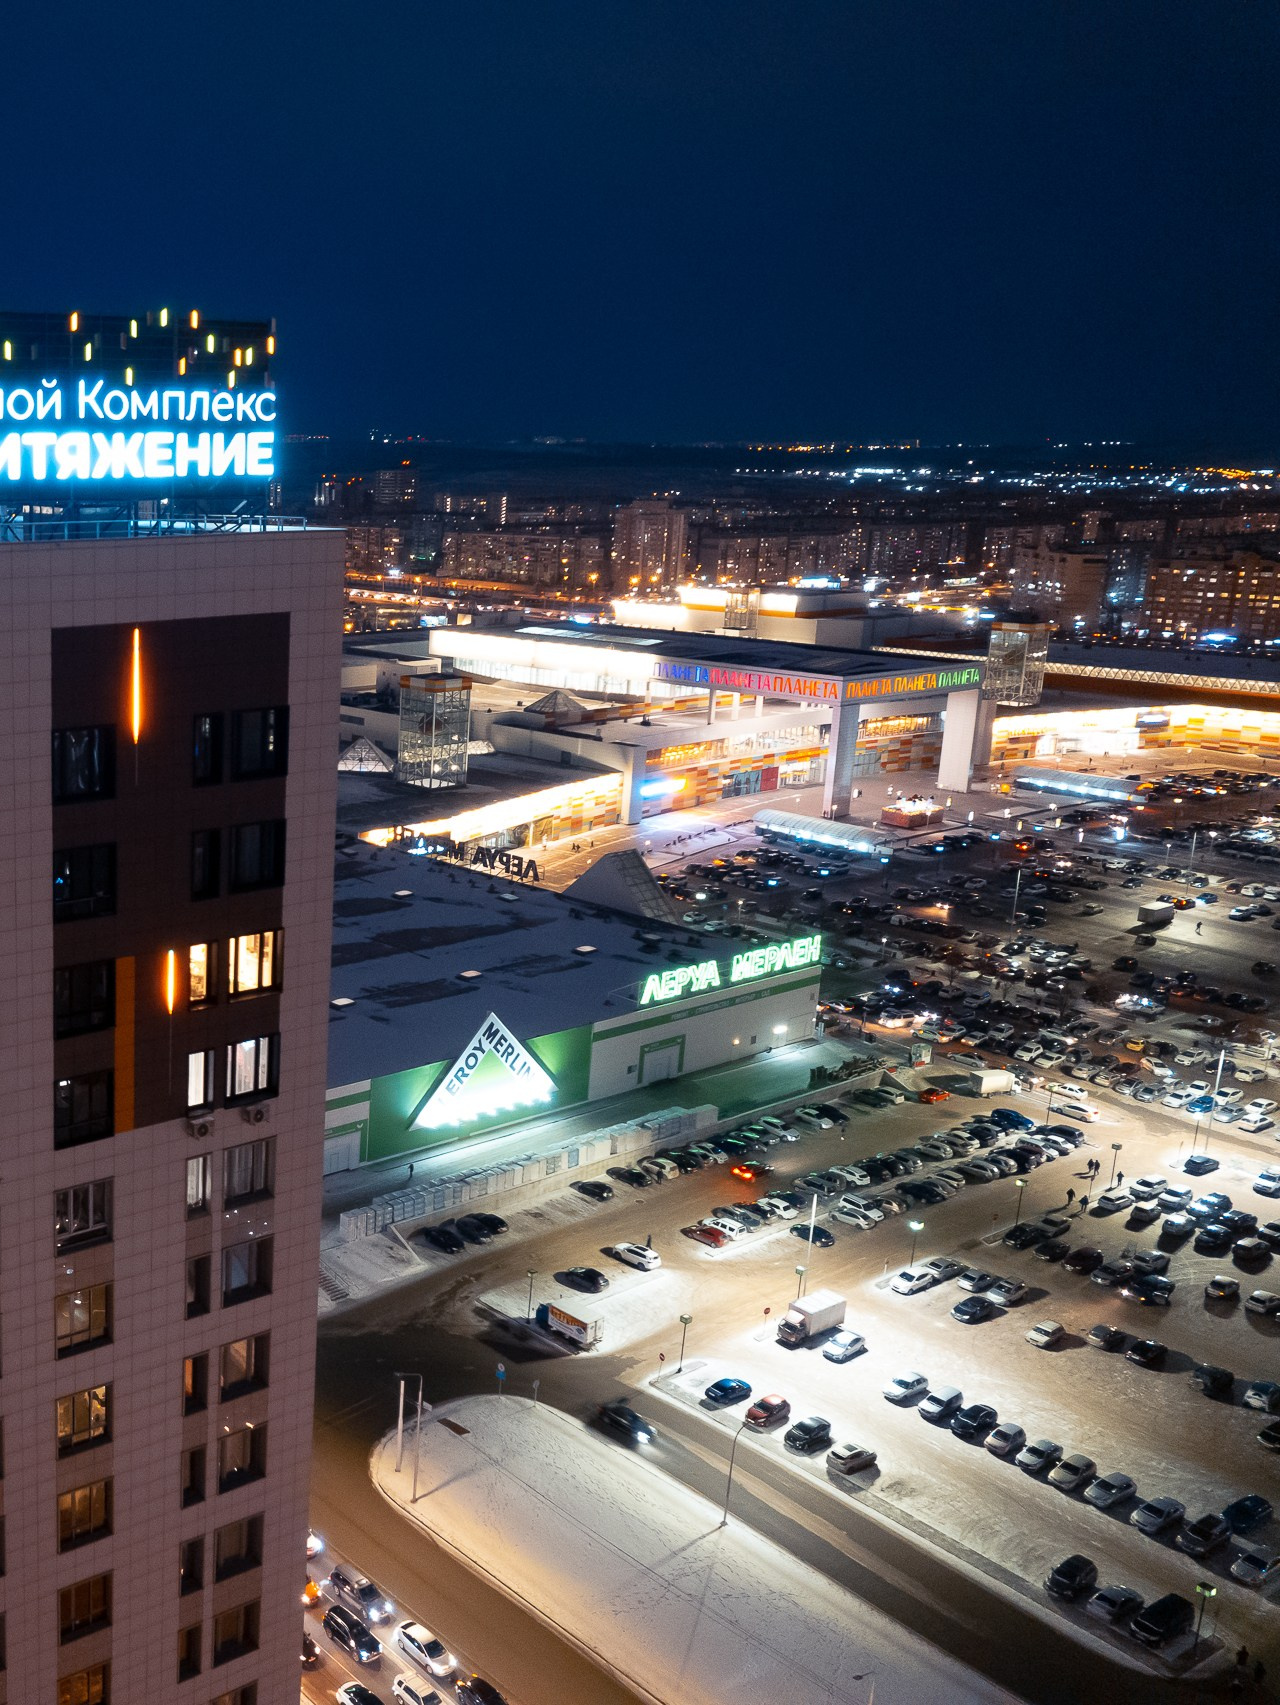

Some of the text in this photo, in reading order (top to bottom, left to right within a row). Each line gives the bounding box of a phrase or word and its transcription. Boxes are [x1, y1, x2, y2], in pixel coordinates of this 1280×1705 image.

[78, 379, 277, 422] Комплекс
[710, 667, 771, 691] ПЛАНЕТА
[773, 676, 838, 699] ПЛАНЕТА
[846, 668, 980, 698] ПЛАНЕТА ПЛАНЕТА ПЛАНЕТА
[640, 960, 721, 1005] ЛЕРУА
[730, 935, 822, 983] МЕРЛЕН
[438, 1037, 486, 1104] EROY
